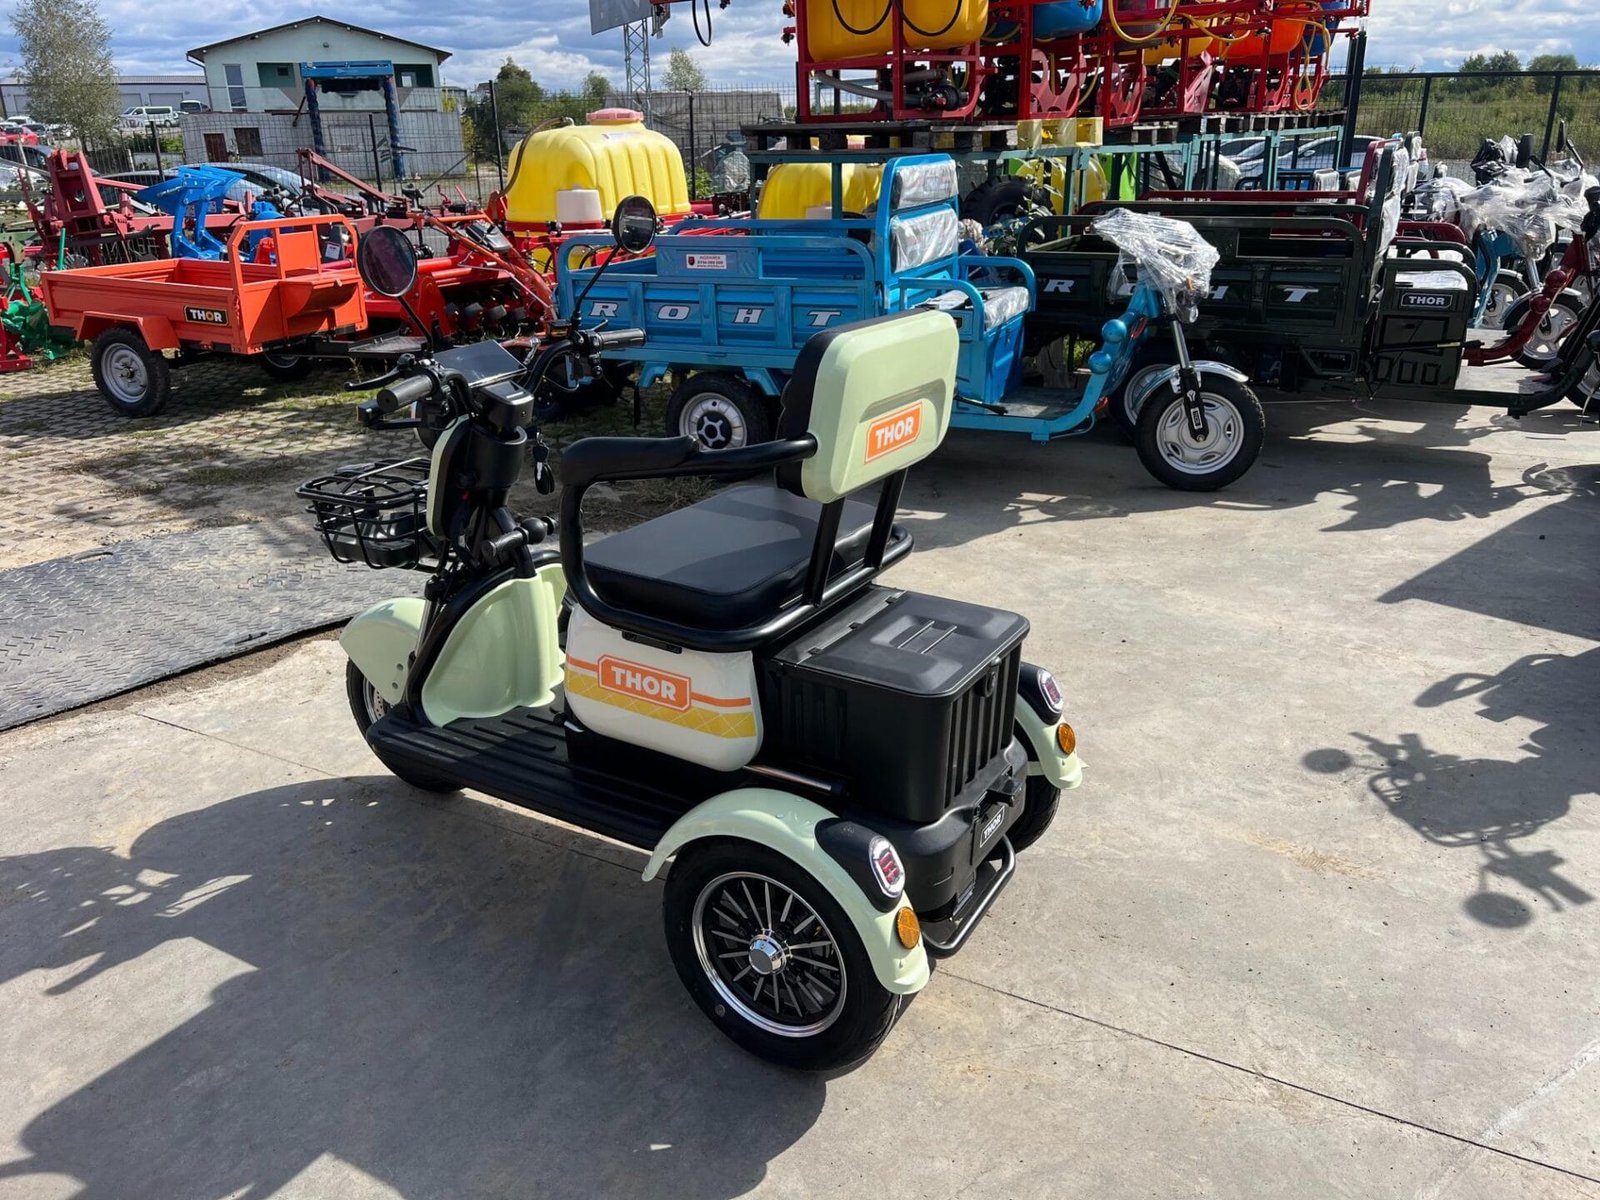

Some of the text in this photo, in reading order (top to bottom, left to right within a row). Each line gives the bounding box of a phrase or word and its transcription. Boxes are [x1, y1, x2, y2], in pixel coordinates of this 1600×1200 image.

[1408, 295, 1446, 305] THOR
[190, 309, 223, 322] THOR
[875, 416, 914, 449] THOR
[610, 666, 677, 701] THOR
[983, 813, 1001, 839] THOR
